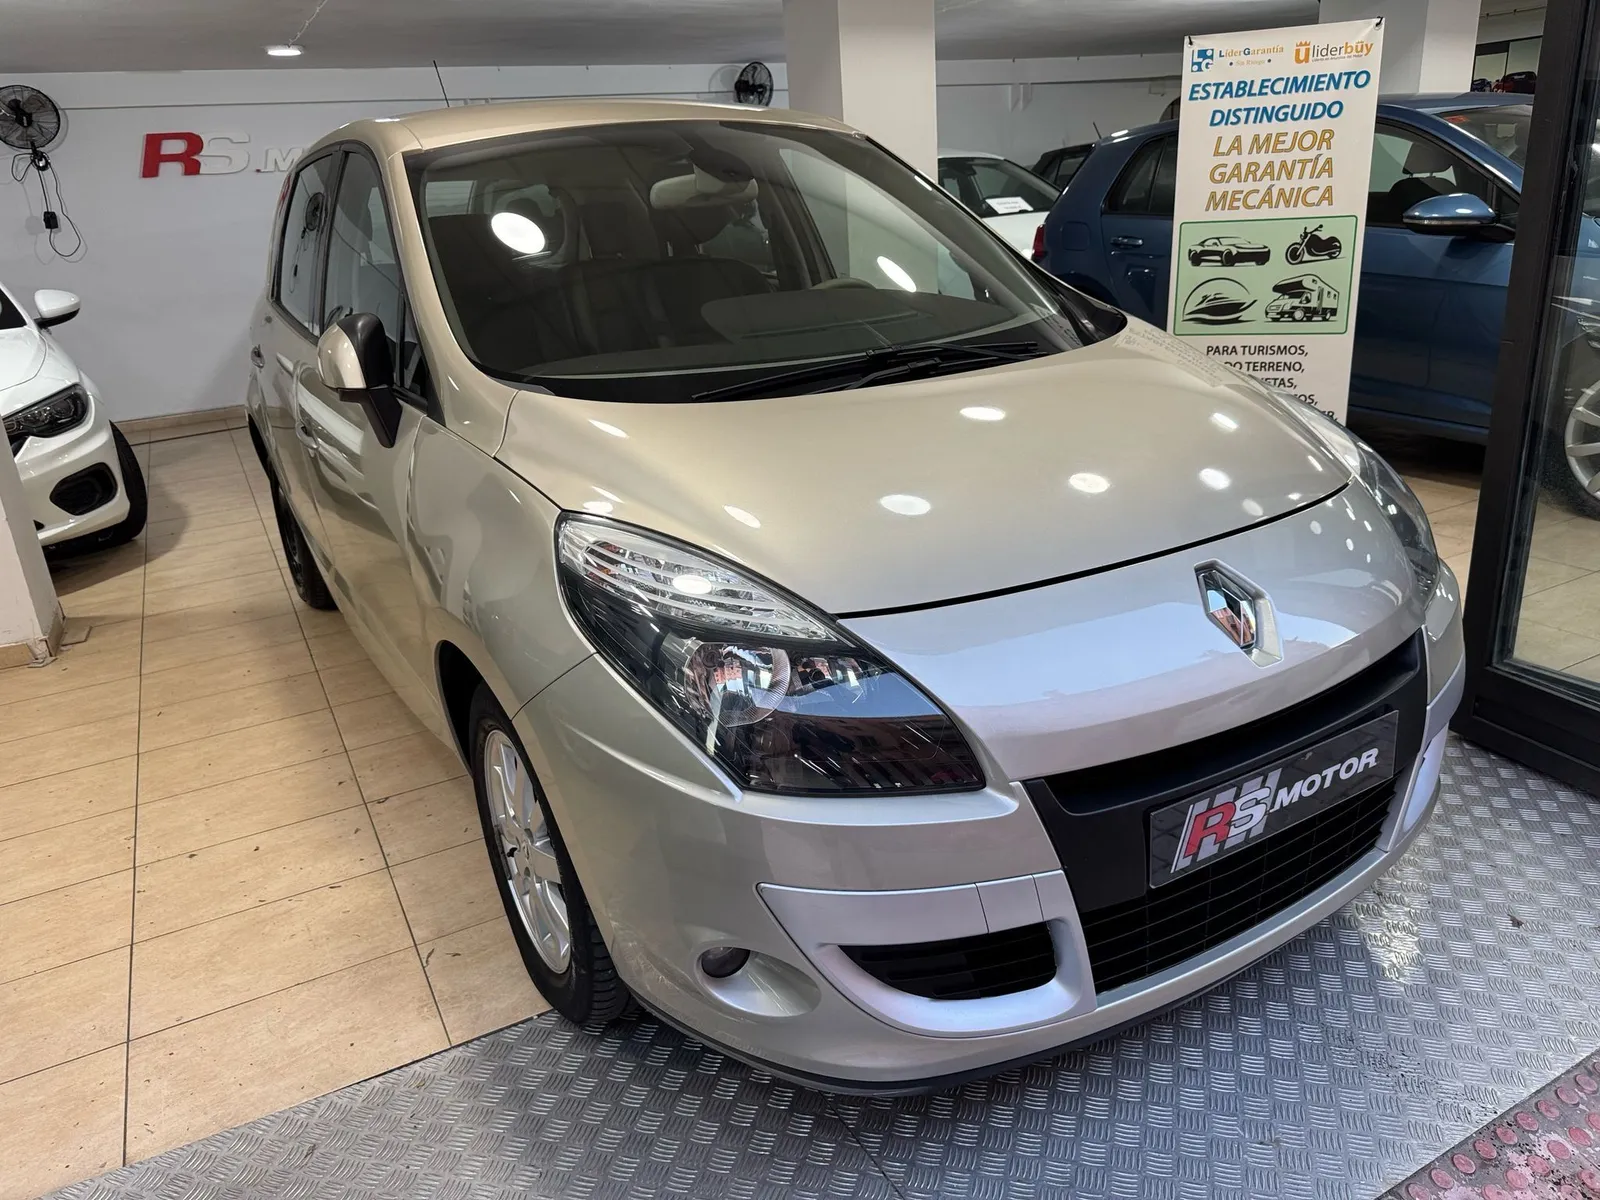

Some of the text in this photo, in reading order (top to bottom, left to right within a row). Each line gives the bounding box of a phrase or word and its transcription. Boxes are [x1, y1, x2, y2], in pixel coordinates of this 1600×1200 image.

[1188, 70, 1371, 101] ESTABLECIMIENTO
[1209, 100, 1344, 127] DISTINGUIDO
[1213, 128, 1335, 157] LA MEJOR
[1209, 153, 1334, 184] GARANTÍA
[1205, 183, 1334, 212] MECÁNICA
[1206, 345, 1309, 357] PARA TURISMOS,
[1244, 361, 1305, 374] TERRENO,
[1268, 747, 1379, 813] MOTOR
